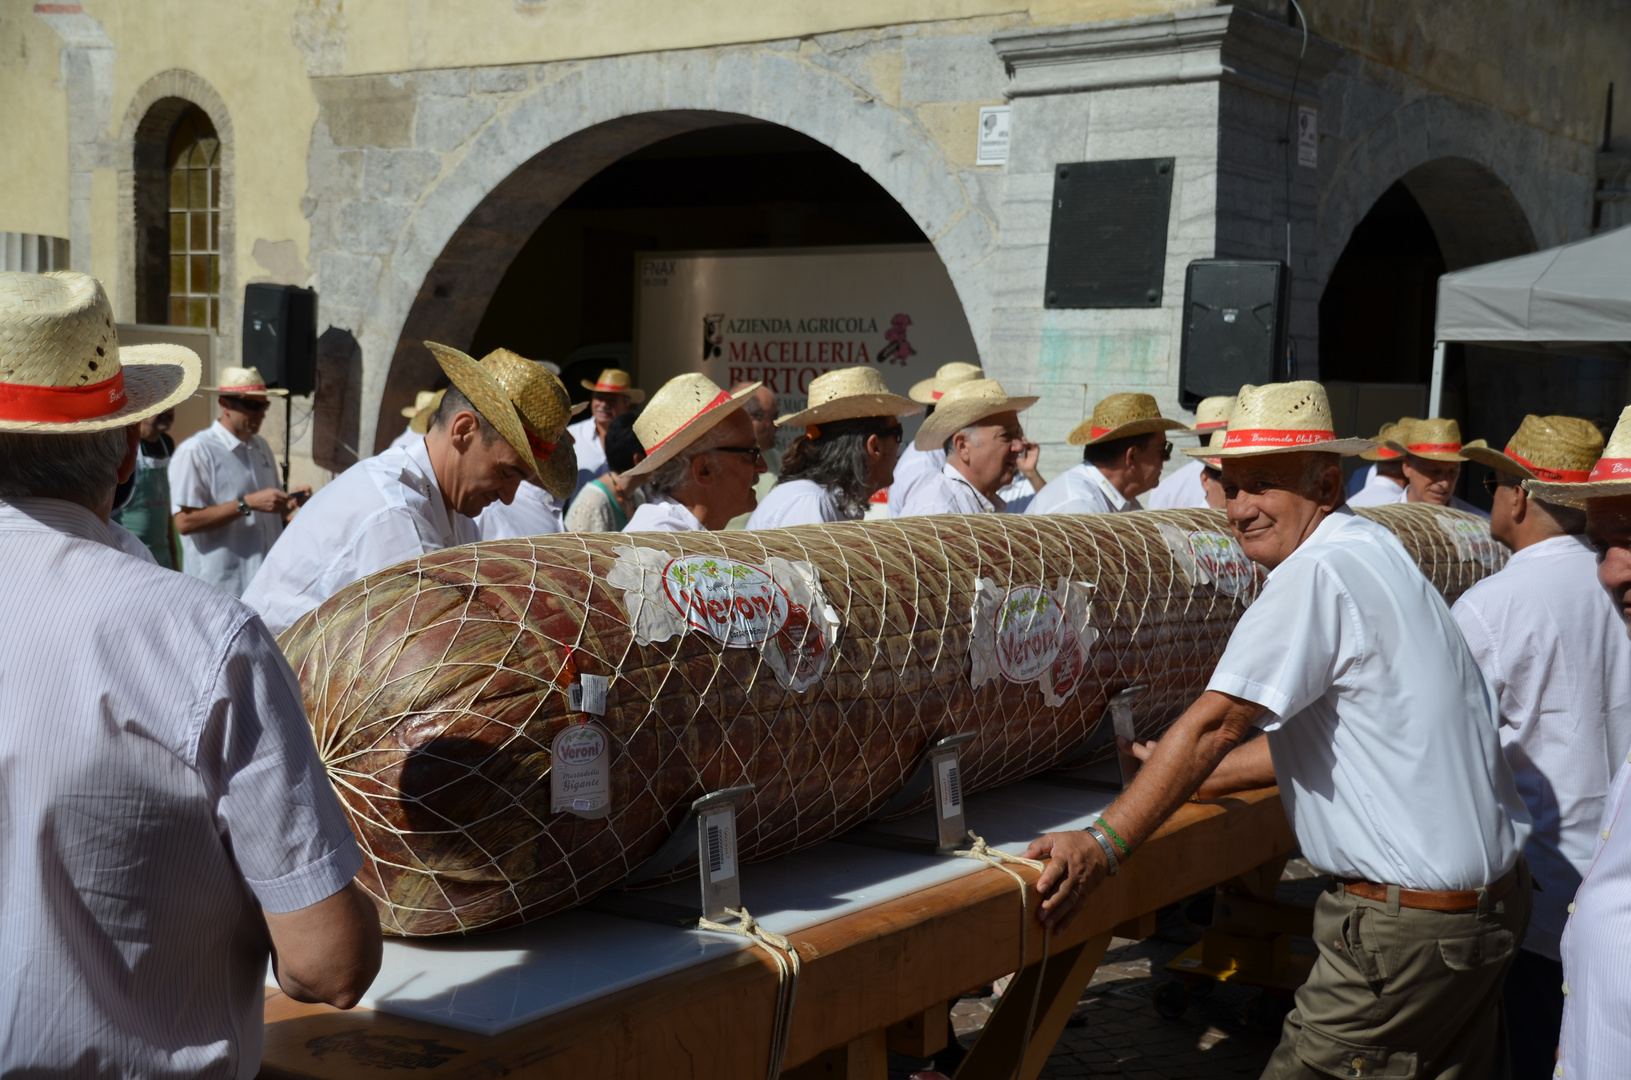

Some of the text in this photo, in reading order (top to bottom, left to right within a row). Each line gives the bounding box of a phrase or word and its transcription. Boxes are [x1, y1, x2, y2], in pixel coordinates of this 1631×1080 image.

[726, 316, 879, 334] AZIENDA AGRICOLA
[728, 340, 871, 364] MACELLERIA
[728, 366, 826, 395] BERTO
[1296, 433, 1313, 443] Club
[1542, 469, 1563, 481] Club
[678, 585, 782, 624] Veroni
[1001, 617, 1059, 668] Veroni
[560, 741, 599, 760] Veroni
[562, 768, 600, 780] Mortadella
[562, 777, 600, 793] Gigante
